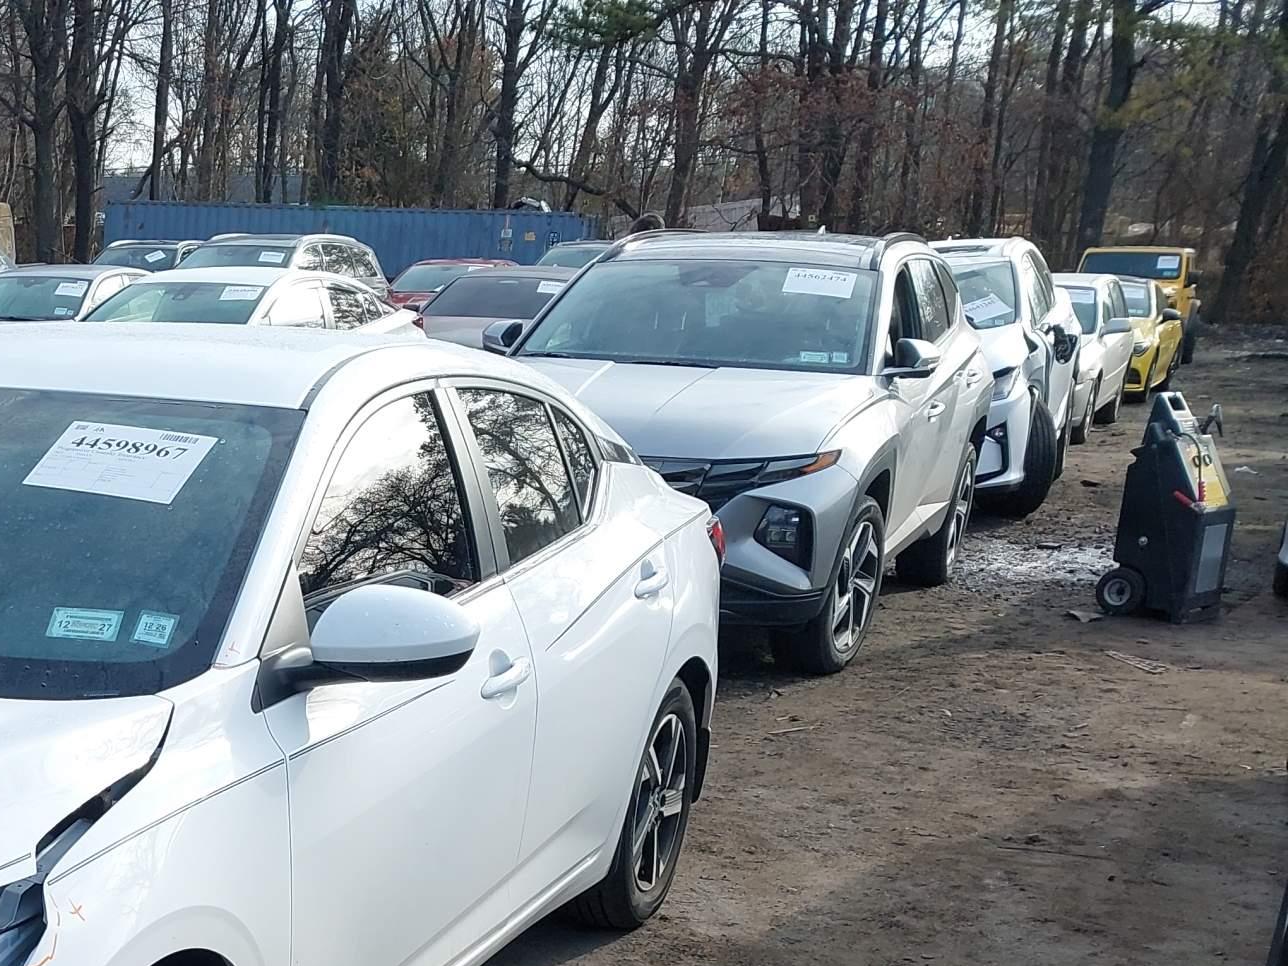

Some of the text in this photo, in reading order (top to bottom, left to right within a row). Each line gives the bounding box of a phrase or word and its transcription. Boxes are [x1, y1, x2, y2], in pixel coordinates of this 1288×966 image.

[71, 435, 189, 460] 44598967
[57, 620, 71, 629] 12
[98, 623, 113, 632] 27
